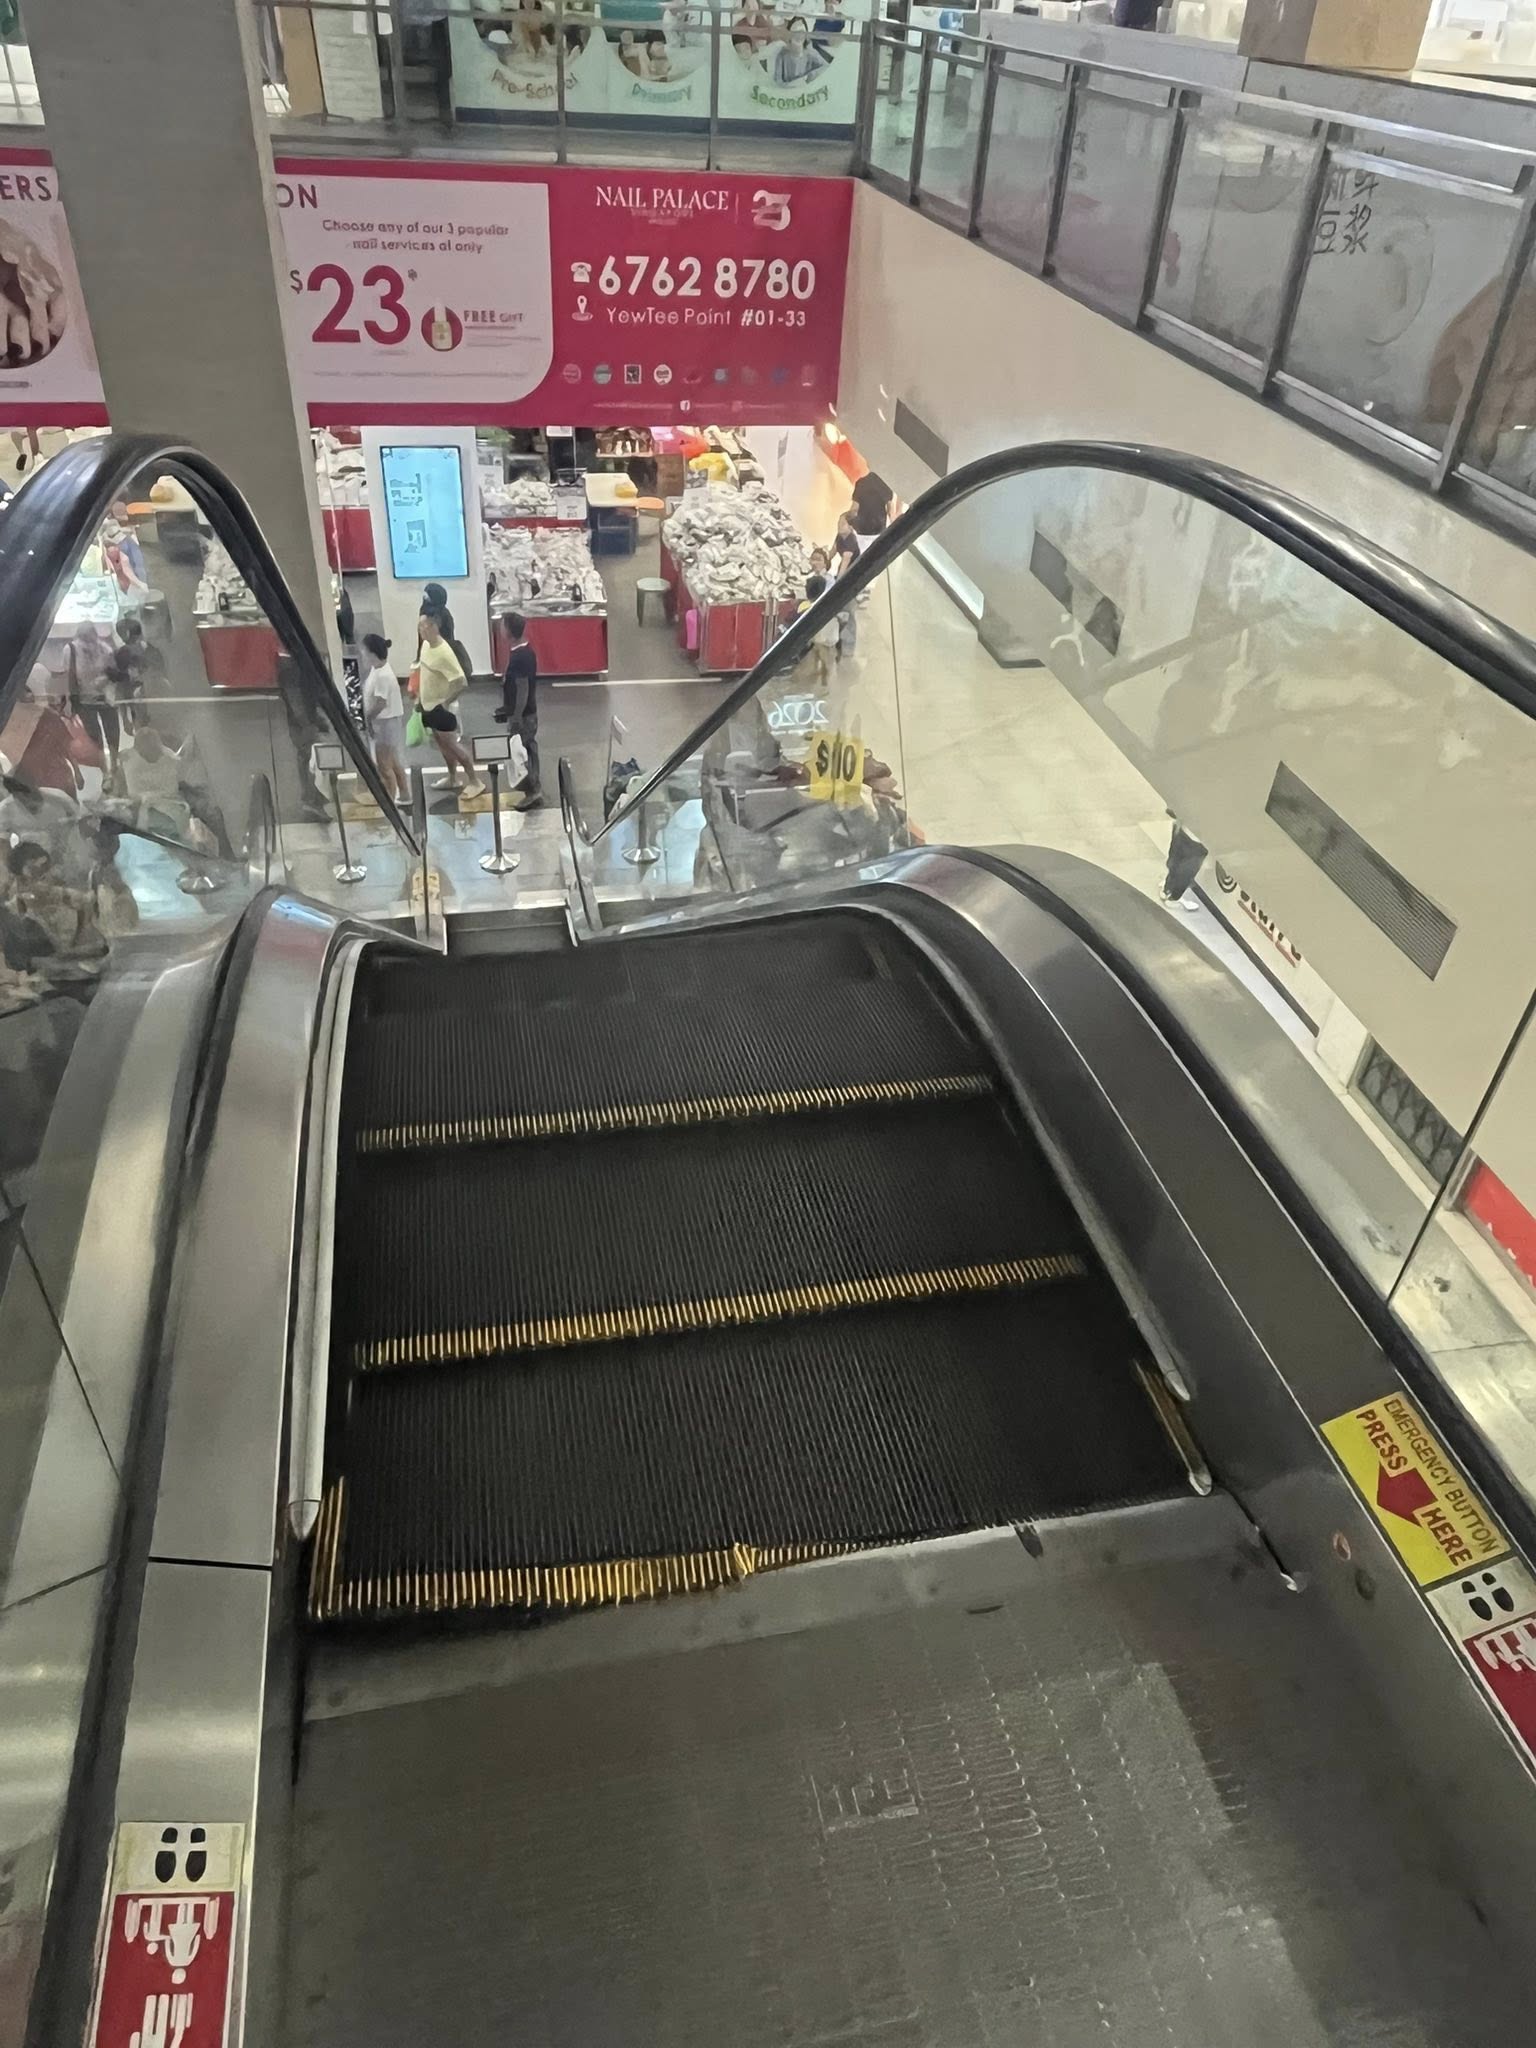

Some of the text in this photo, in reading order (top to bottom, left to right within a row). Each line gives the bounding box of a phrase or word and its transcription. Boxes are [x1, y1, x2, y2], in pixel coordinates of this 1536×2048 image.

[491, 68, 578, 99] Pre-Schol
[751, 84, 829, 110] Secondary
[0, 174, 51, 201] ERS
[596, 186, 729, 211] NAIL PALACE
[322, 219, 374, 232] Choose
[378, 222, 403, 234] any
[407, 221, 419, 233] of
[423, 223, 443, 234] our
[458, 224, 509, 237] popular
[382, 240, 435, 251] services
[456, 241, 483, 254] only
[598, 255, 816, 300] 6762 8780
[464, 310, 496, 323] FREE
[684, 308, 731, 326] Point
[740, 309, 806, 327] #01-33
[1356, 1408, 1408, 1471] PRESS
[1384, 1398, 1501, 1554] EMERGENCY BUTTON
[1421, 1507, 1473, 1567] HERE
